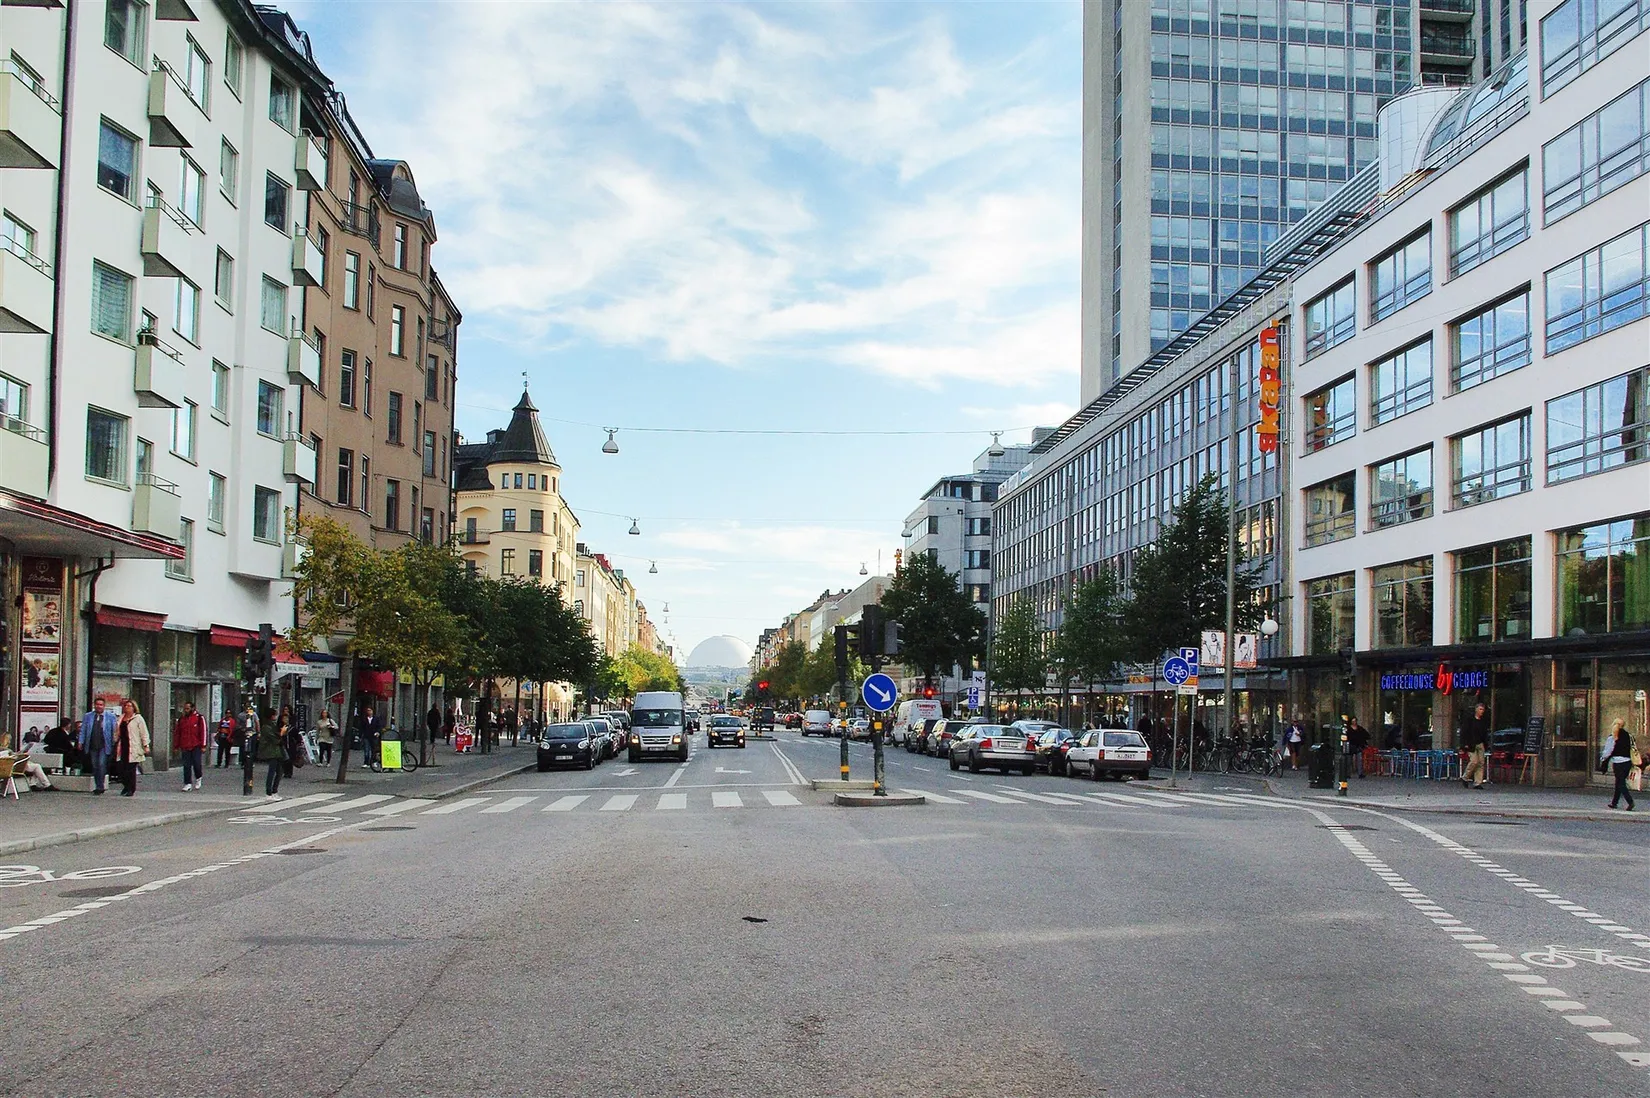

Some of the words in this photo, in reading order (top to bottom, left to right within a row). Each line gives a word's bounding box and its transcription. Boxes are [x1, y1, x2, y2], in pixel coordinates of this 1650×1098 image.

[1186, 650, 1195, 661] P
[1381, 673, 1434, 690] COFFEEHOUSE
[1436, 663, 1453, 696] by
[1453, 671, 1488, 688] GEORGE
